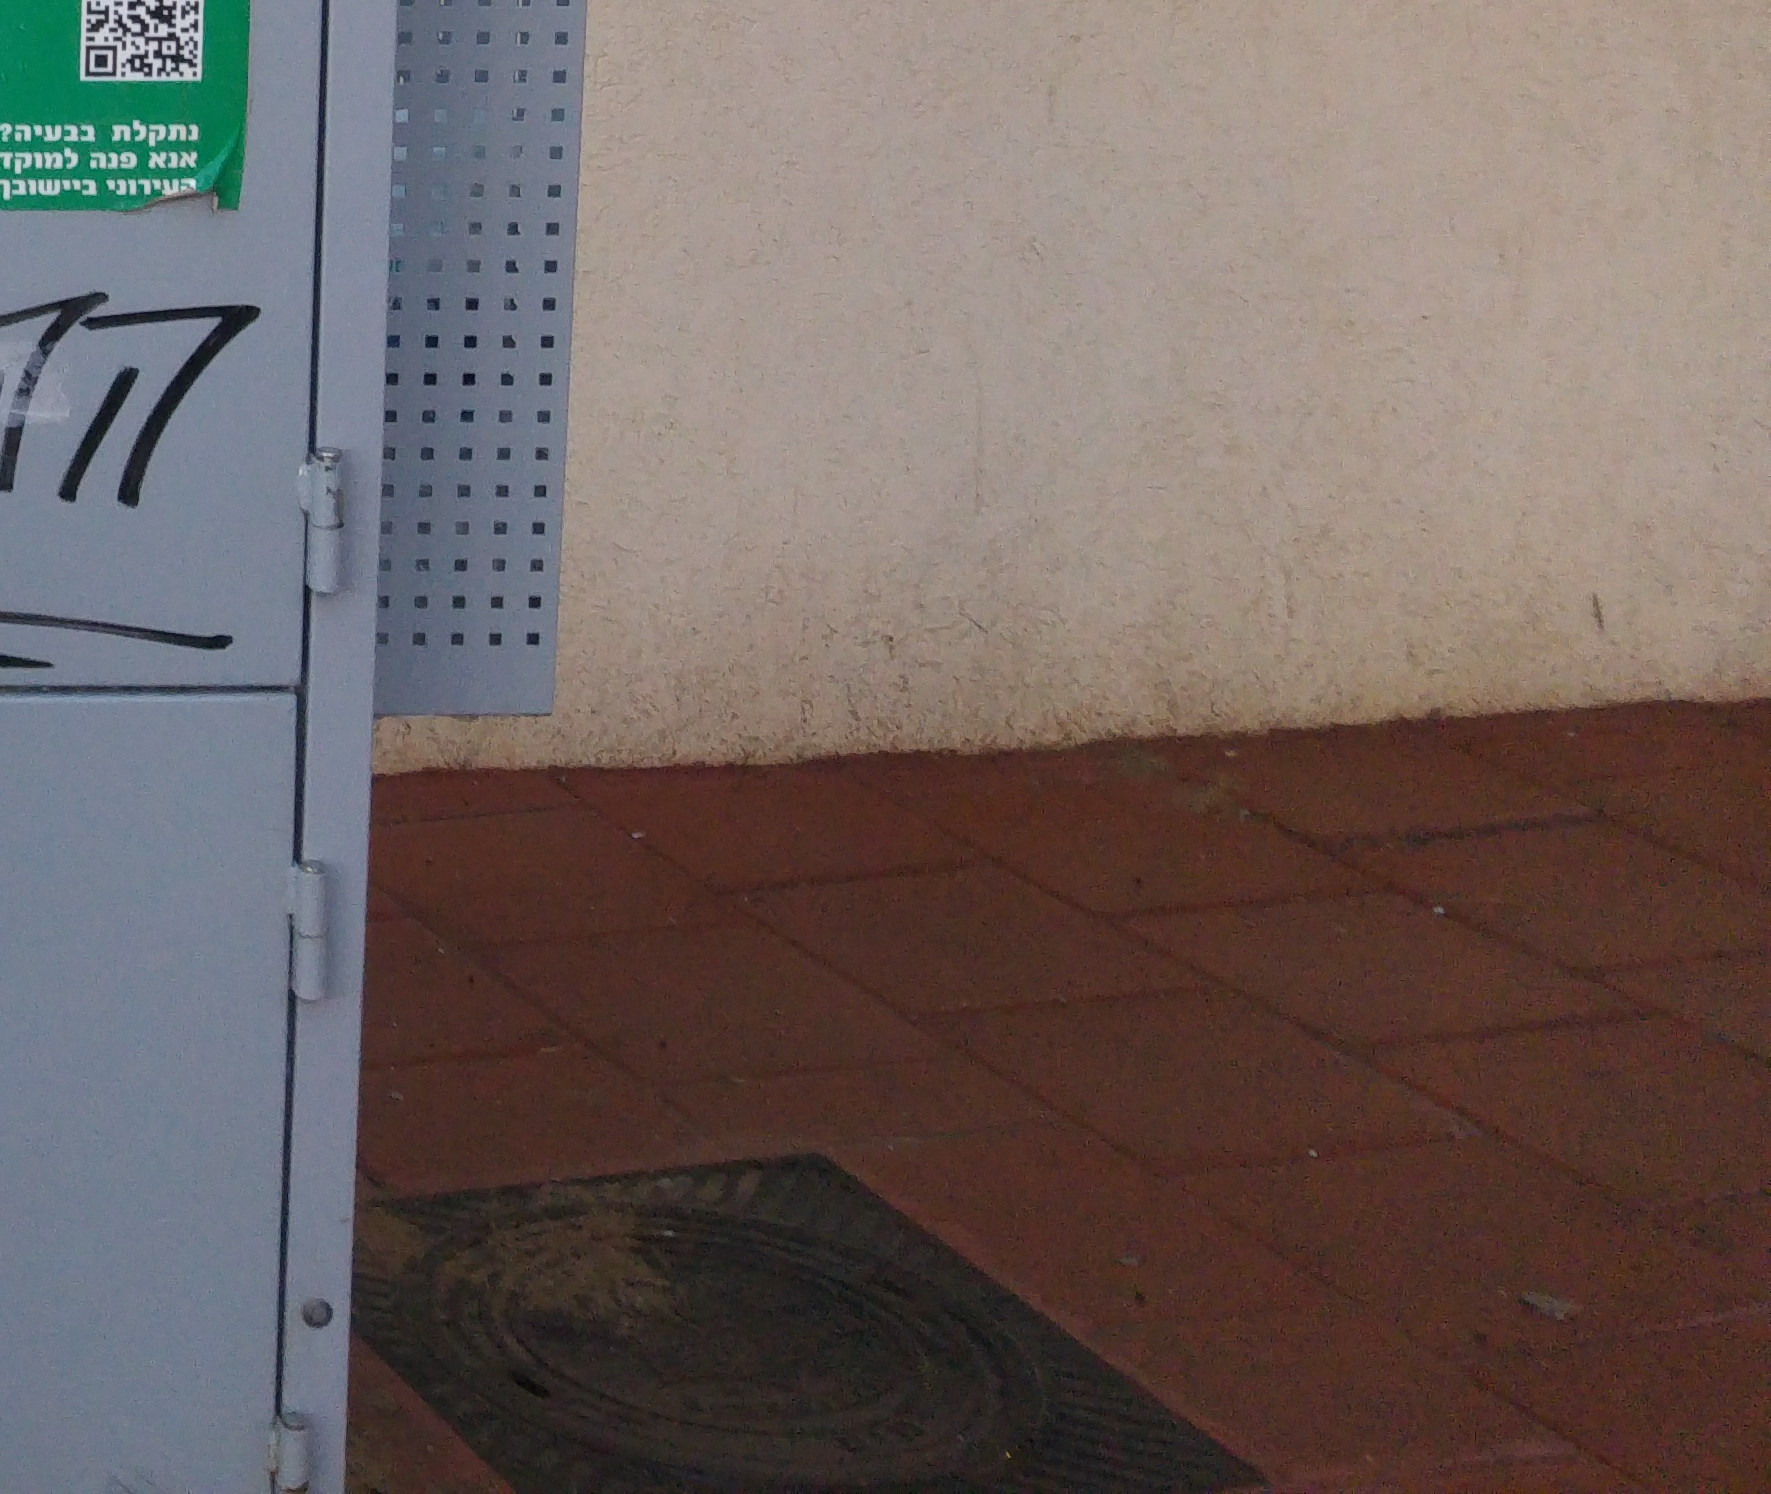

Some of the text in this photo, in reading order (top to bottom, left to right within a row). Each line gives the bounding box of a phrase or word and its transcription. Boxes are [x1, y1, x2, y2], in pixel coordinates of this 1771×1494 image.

[111, 119, 199, 147] נתקלת
[89, 151, 138, 170] פנה
[148, 150, 198, 169] אנא
